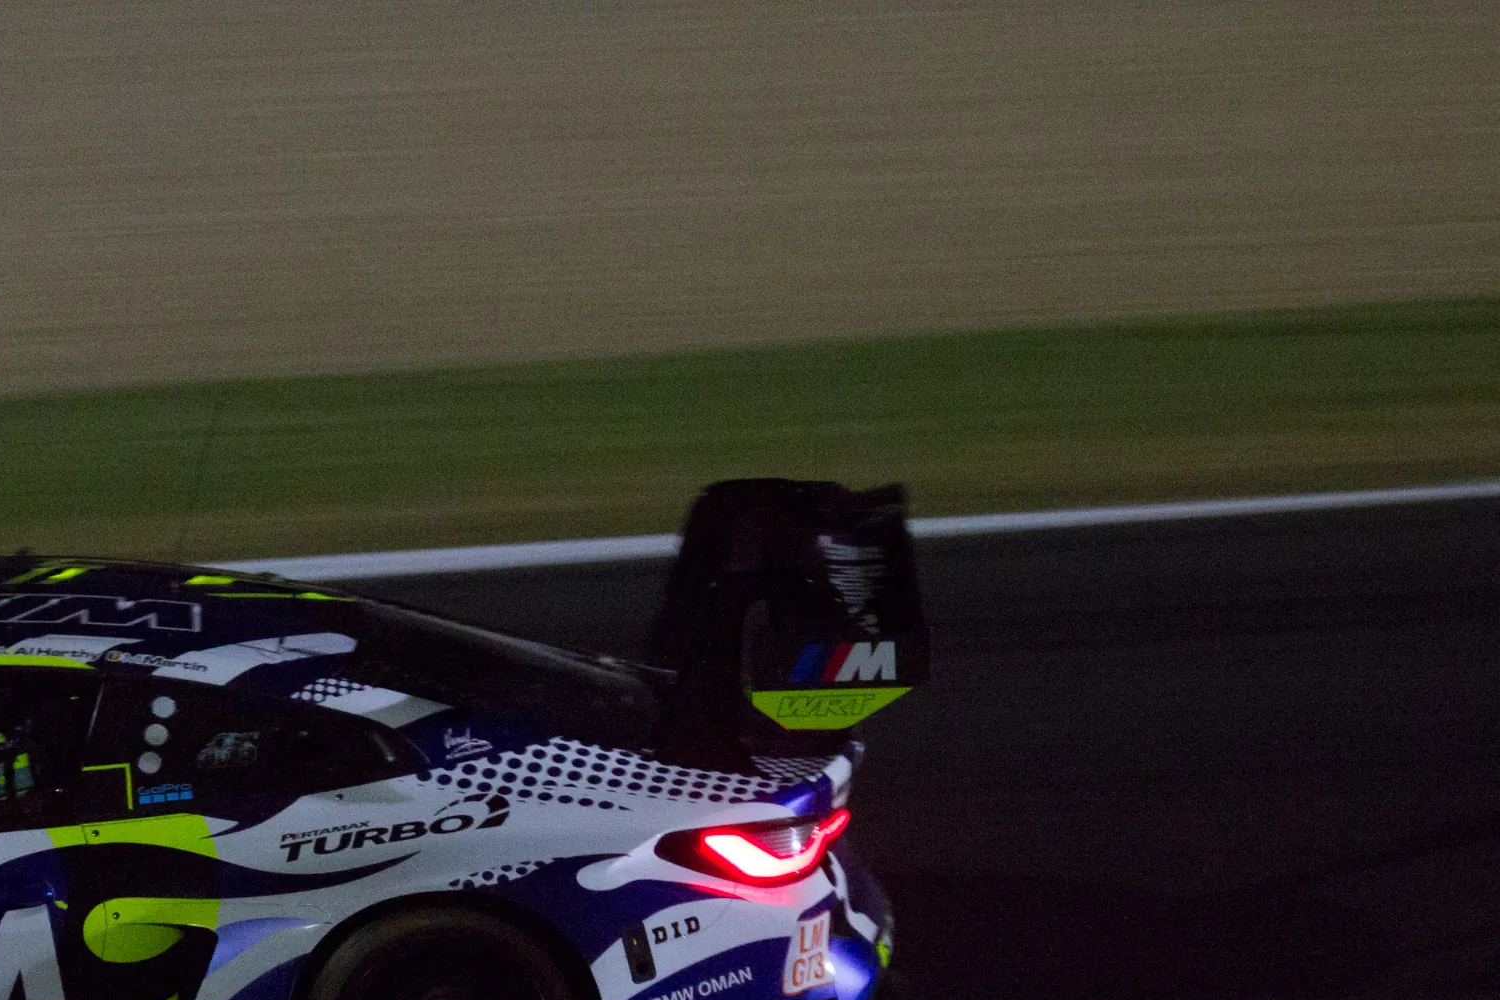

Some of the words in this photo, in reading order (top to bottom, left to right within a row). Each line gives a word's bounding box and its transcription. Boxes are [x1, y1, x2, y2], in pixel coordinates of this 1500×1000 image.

[38, 648, 98, 664] Harthy
[145, 656, 208, 673] Martin
[776, 694, 876, 717] WRT
[137, 783, 192, 795] GoPro
[280, 815, 474, 862] TURBO
[791, 951, 826, 987] GT3
[698, 966, 753, 998] OMAN
